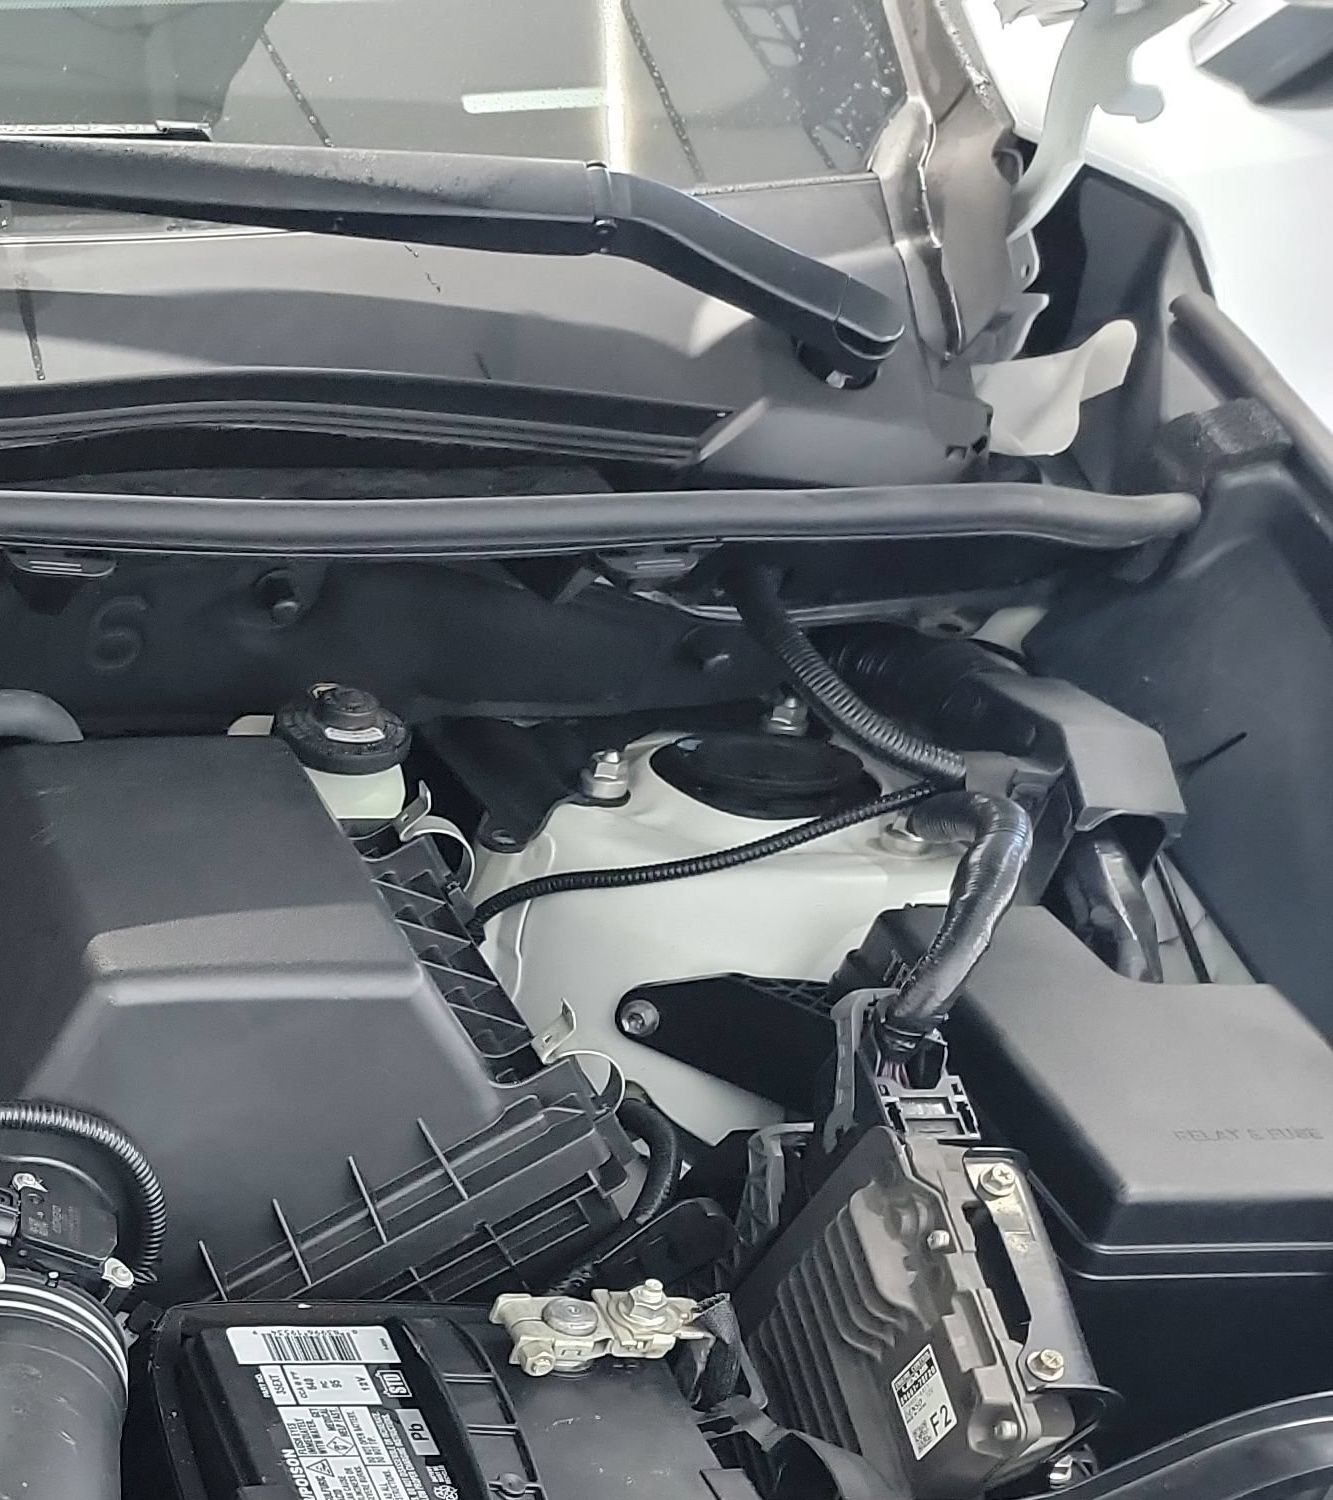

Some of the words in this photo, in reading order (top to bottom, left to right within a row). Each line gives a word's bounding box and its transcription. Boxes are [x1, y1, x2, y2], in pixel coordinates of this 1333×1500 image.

[268, 1374, 286, 1394] 35EXT
[355, 1376, 370, 1390] 12V
[382, 1373, 407, 1394] STD
[930, 1405, 952, 1437] F2
[407, 1423, 428, 1440] Pb
